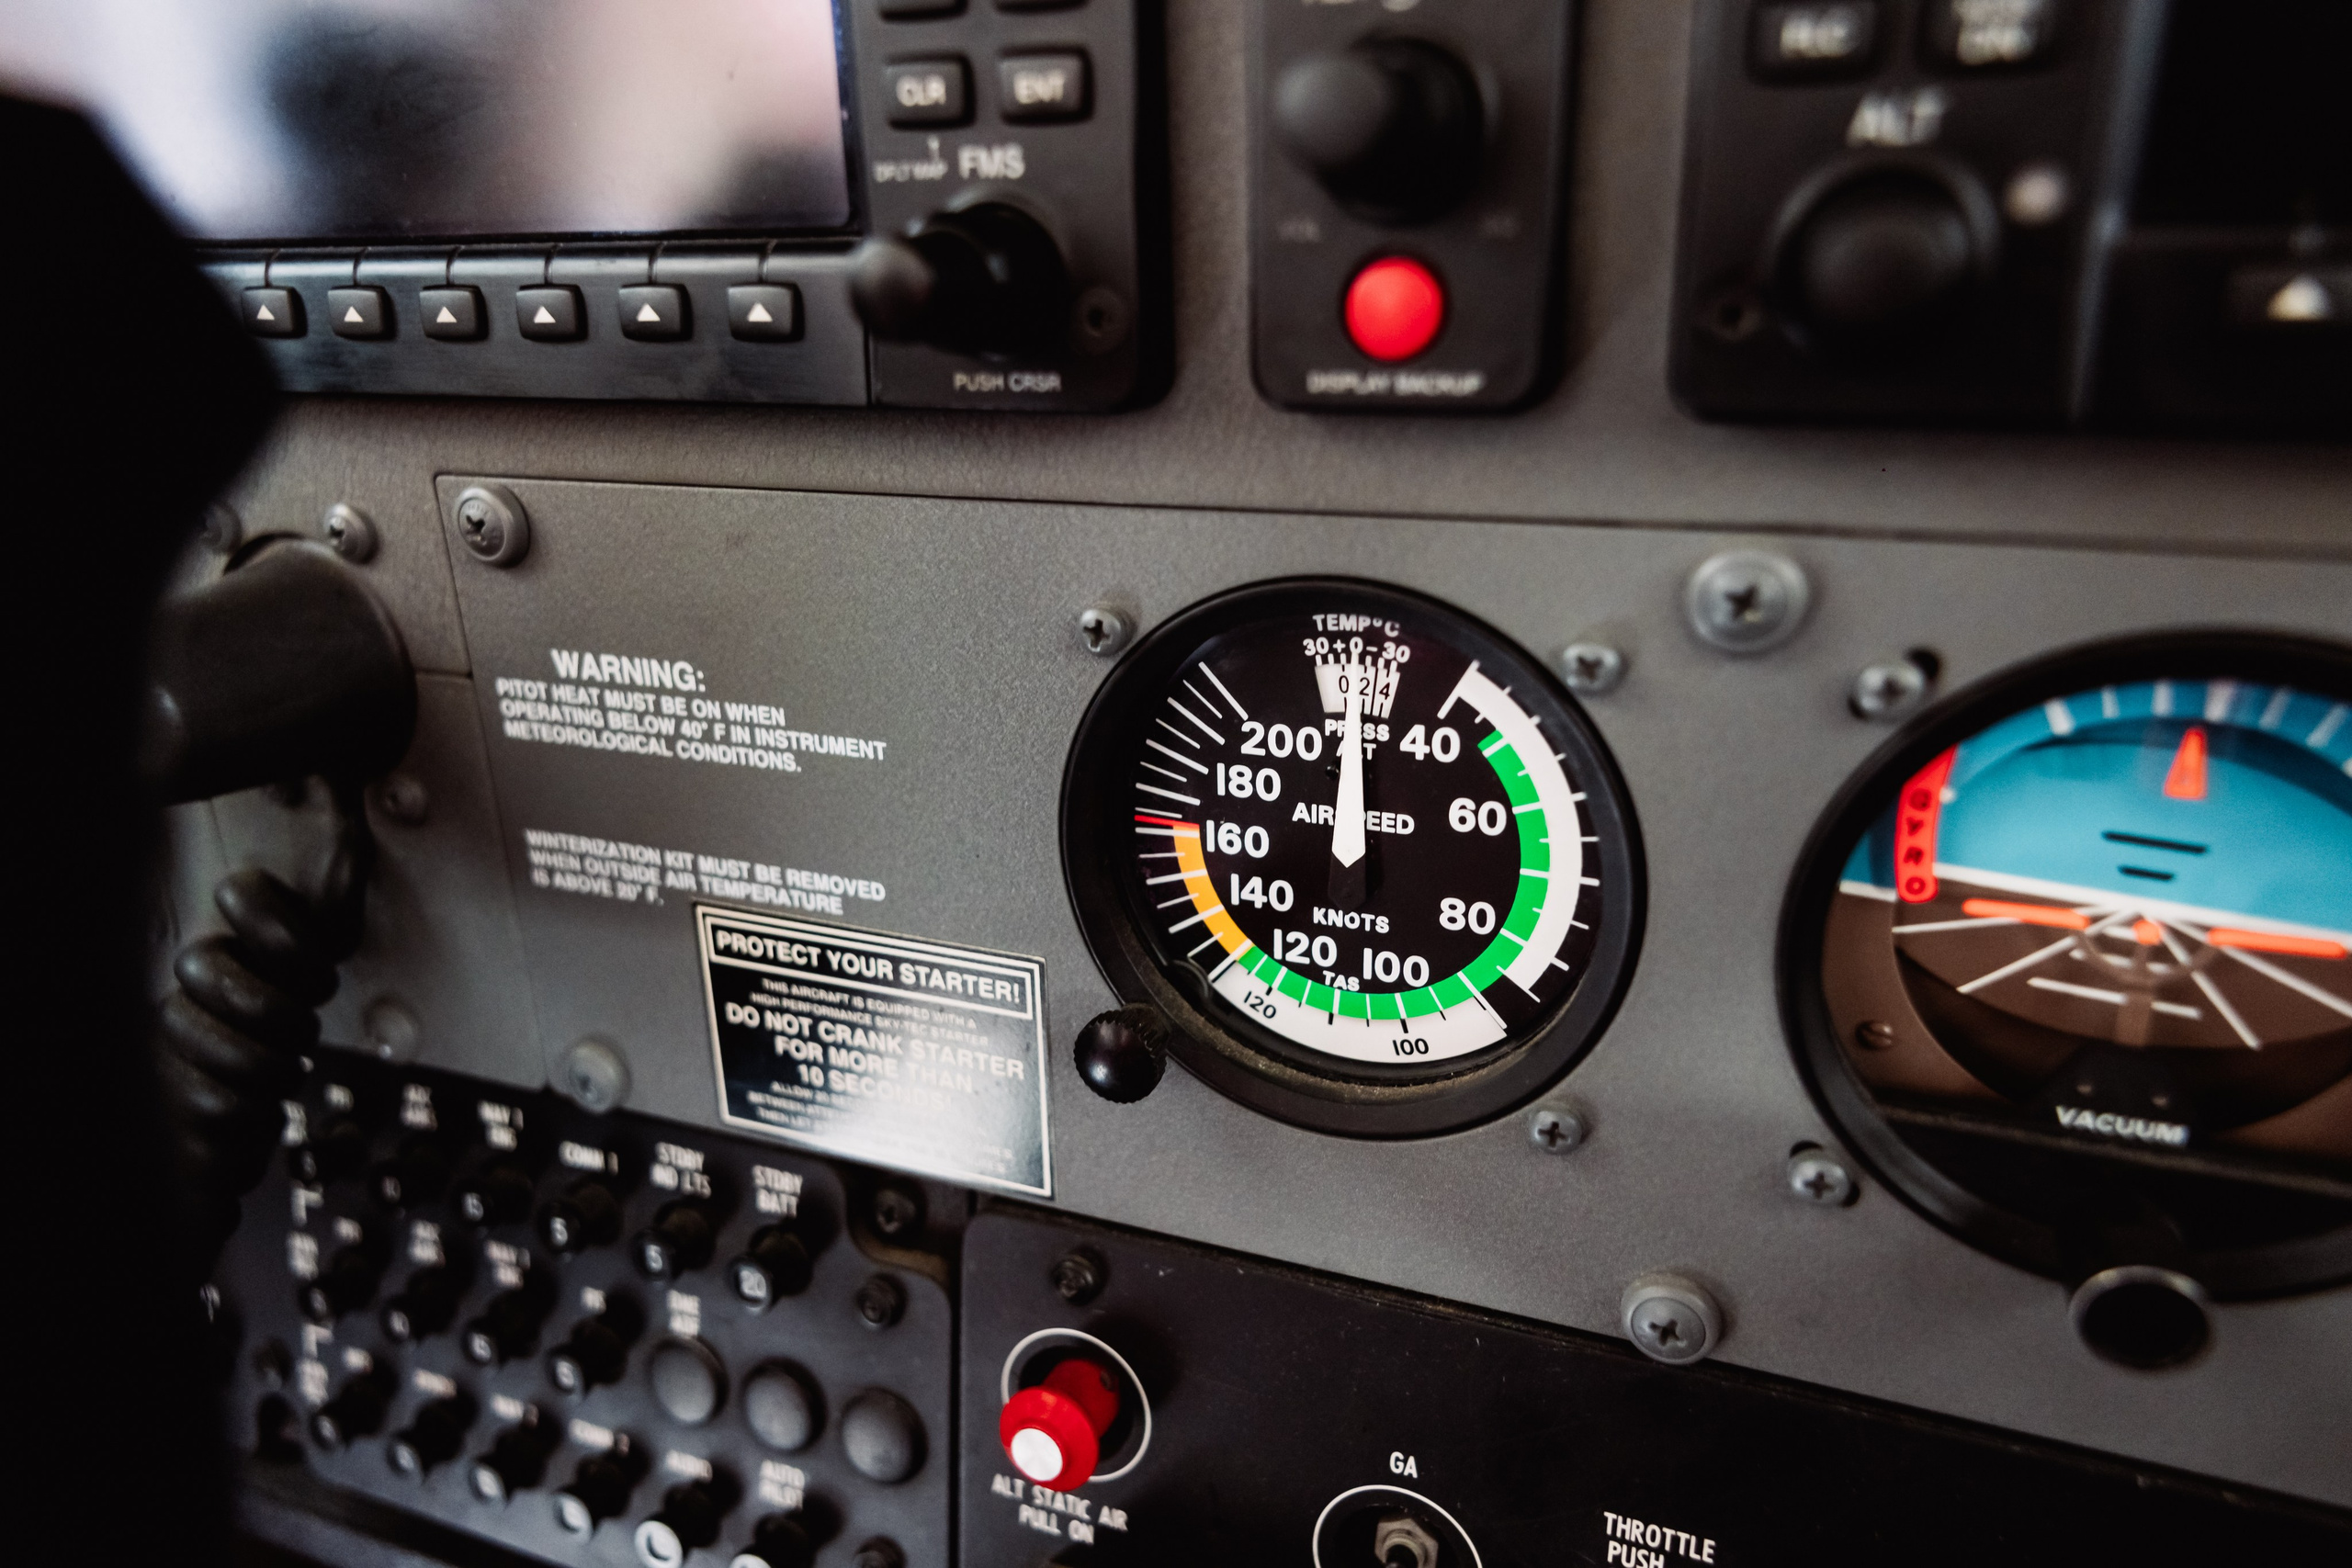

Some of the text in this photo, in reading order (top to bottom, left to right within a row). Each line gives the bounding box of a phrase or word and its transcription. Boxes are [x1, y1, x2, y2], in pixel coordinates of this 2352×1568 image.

[897, 73, 946, 107] CLR
[958, 142, 1026, 180] FMS
[954, 371, 1004, 391] PUSH
[551, 649, 706, 693] WARNING:
[496, 676, 786, 727] PITOT HEAT MUST BE ON WHEN
[499, 698, 605, 728] OPERATING
[607, 710, 675, 736] BELOW
[713, 723, 726, 741] F
[729, 725, 751, 745] IN
[754, 727, 887, 761] INSTRUMENT
[503, 719, 802, 773] METEOROLOGICAL CONDITIONS.
[1240, 720, 1323, 761] 200
[1399, 724, 1461, 763] 40
[1216, 762, 1282, 802] 180
[1292, 802, 1416, 835] AIREED
[1448, 797, 1507, 837] 60
[1205, 819, 1270, 858] 160
[525, 829, 886, 901] WINTERIZATION KIT MUST BE REMOVED
[529, 849, 843, 915] WHEN OUTSIDE AIR TEMPERATURE
[531, 867, 550, 887] IS
[551, 870, 614, 898] ABOVE
[1230, 873, 1295, 912] 140
[1313, 906, 1390, 934] KNOTS
[1439, 897, 1497, 935] 80
[716, 930, 1020, 1004] PROTECT YOUR STARTER!
[1273, 928, 1338, 968] 120
[1363, 947, 1430, 987] 100
[1322, 970, 1361, 992] TAS
[749, 990, 780, 1008] HIGH
[781, 997, 874, 1027] PERFORMANCE
[762, 977, 789, 996] THIS
[790, 983, 850, 1006] AIRCRAFT
[851, 995, 865, 1010] IS
[865, 997, 930, 1021] EQUIPPED
[932, 1010, 965, 1028] WITH
[1243, 990, 1277, 1020] 120
[725, 1000, 1026, 1081] DO NOT CRANK STARTER
[1392, 1037, 1430, 1056] 100
[775, 1033, 974, 1093] FOR MORE THAN
[797, 1063, 825, 1088] 10
[2055, 1105, 2189, 1145] VACUUM
[1389, 1451, 1418, 1479] GA
[991, 1472, 1128, 1532] ALT STATIC AIR
[1018, 1504, 1094, 1545] PULL ON
[1603, 1511, 1715, 1563] THROTTLE
[1608, 1540, 1665, 1568] PUSH
